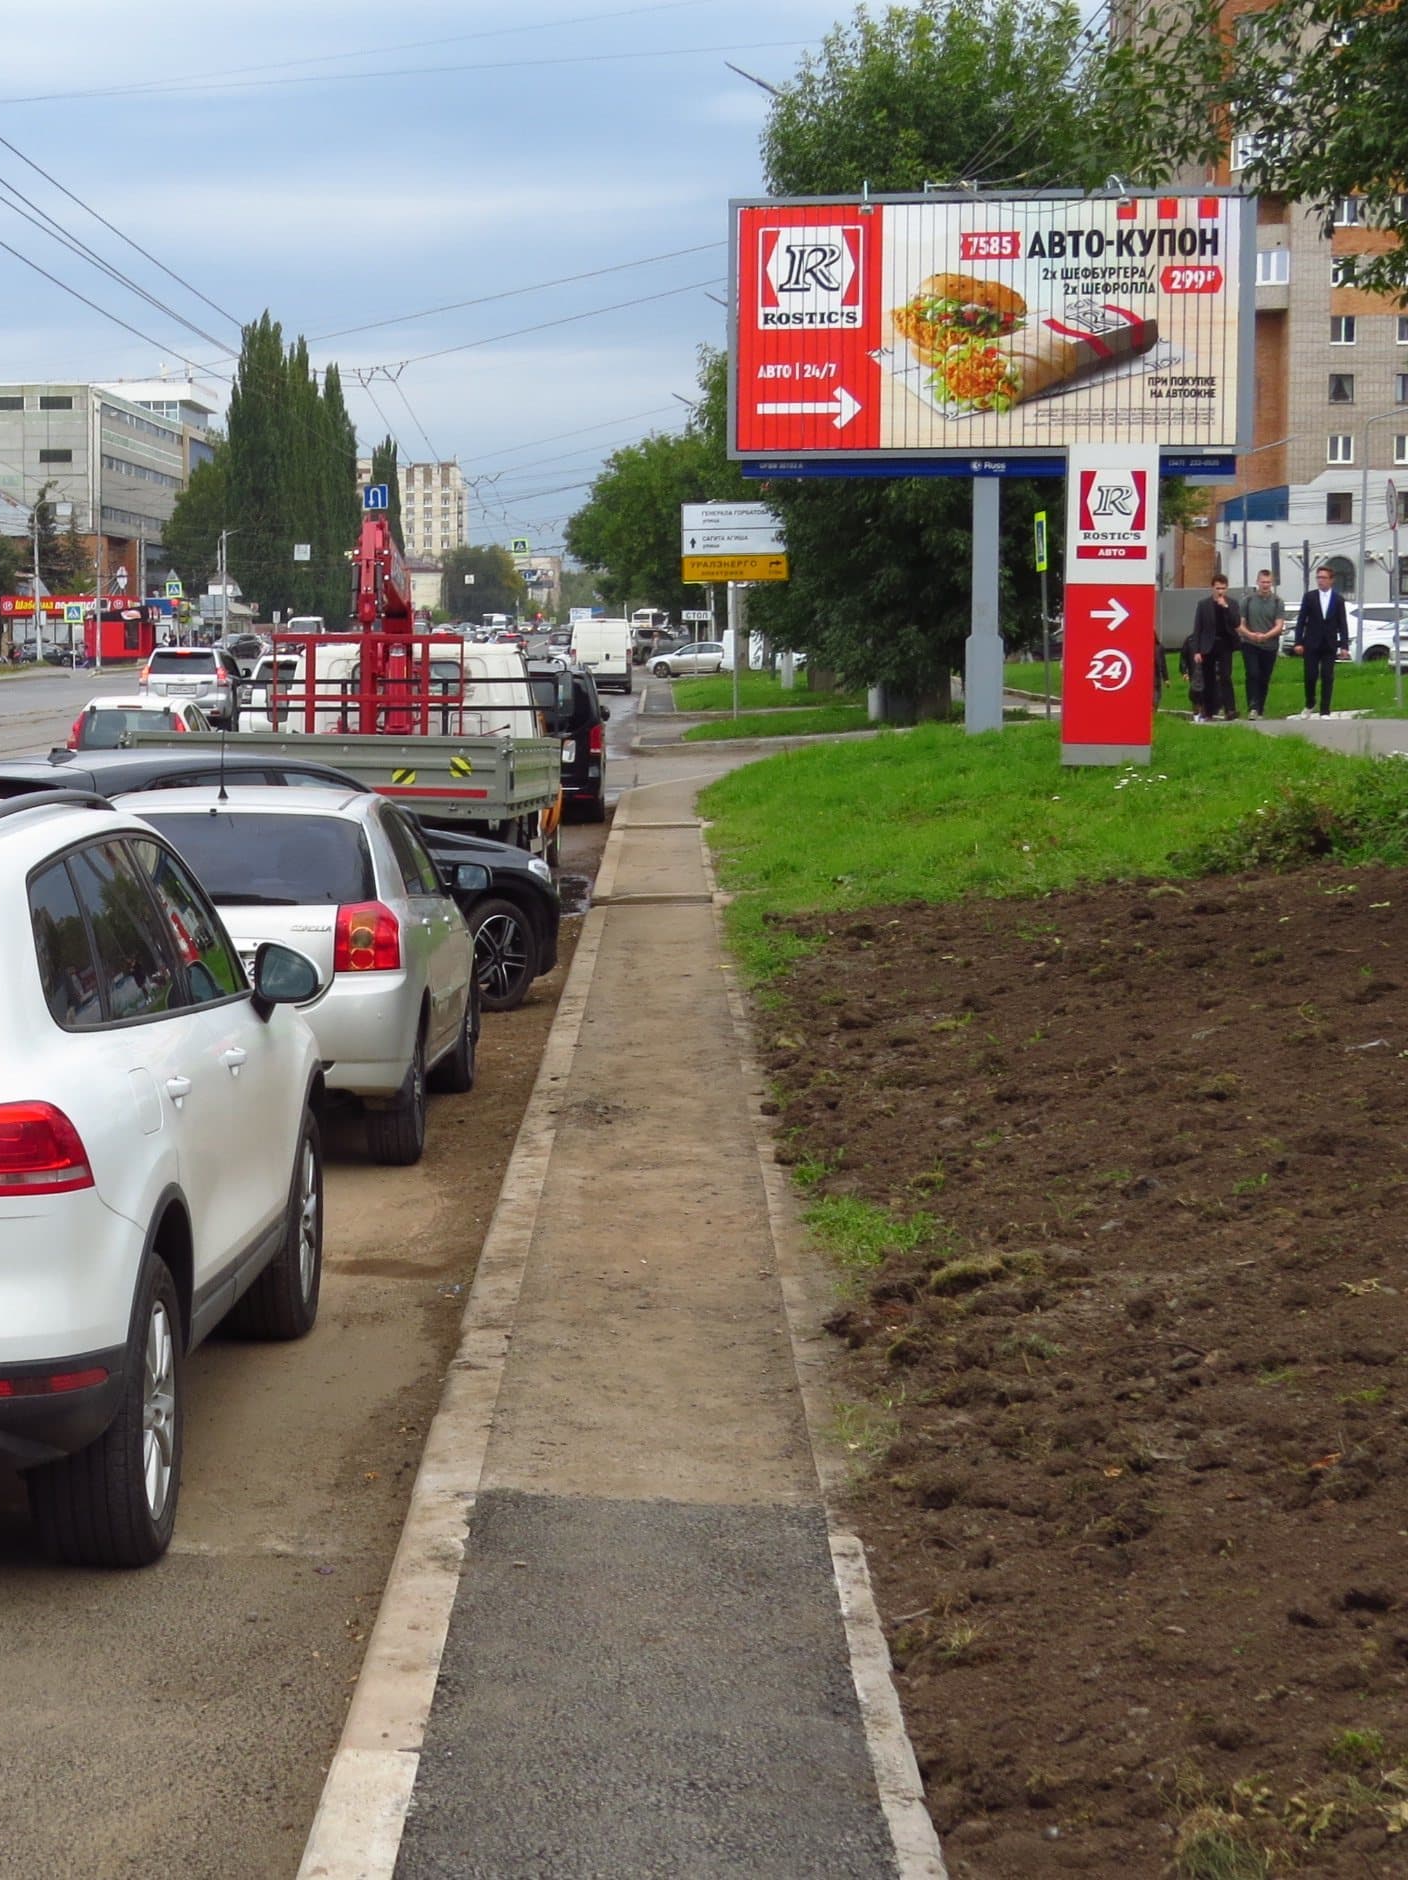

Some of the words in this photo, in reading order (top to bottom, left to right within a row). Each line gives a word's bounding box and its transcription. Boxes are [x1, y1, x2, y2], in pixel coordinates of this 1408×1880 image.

[968, 236, 1013, 255] 7585
[1027, 228, 1219, 259] АВТО-КУПОН
[1061, 265, 1156, 281] ШЕФБУРГЕРА/
[1081, 283, 1156, 295] ШЕФРОЛЛА
[763, 312, 857, 325] ROSTIC'S
[757, 364, 792, 379] АВТО
[804, 363, 837, 378] 24/7
[1148, 377, 1167, 386] ПРИ
[1170, 377, 1216, 386] ПОКУПКЕ
[1150, 389, 1164, 398] НА
[1166, 389, 1216, 398] АВТООКНЕ
[1083, 532, 1141, 540] ROSTIC'S
[1098, 548, 1126, 556] АВТО
[1085, 660, 1122, 679] 24
